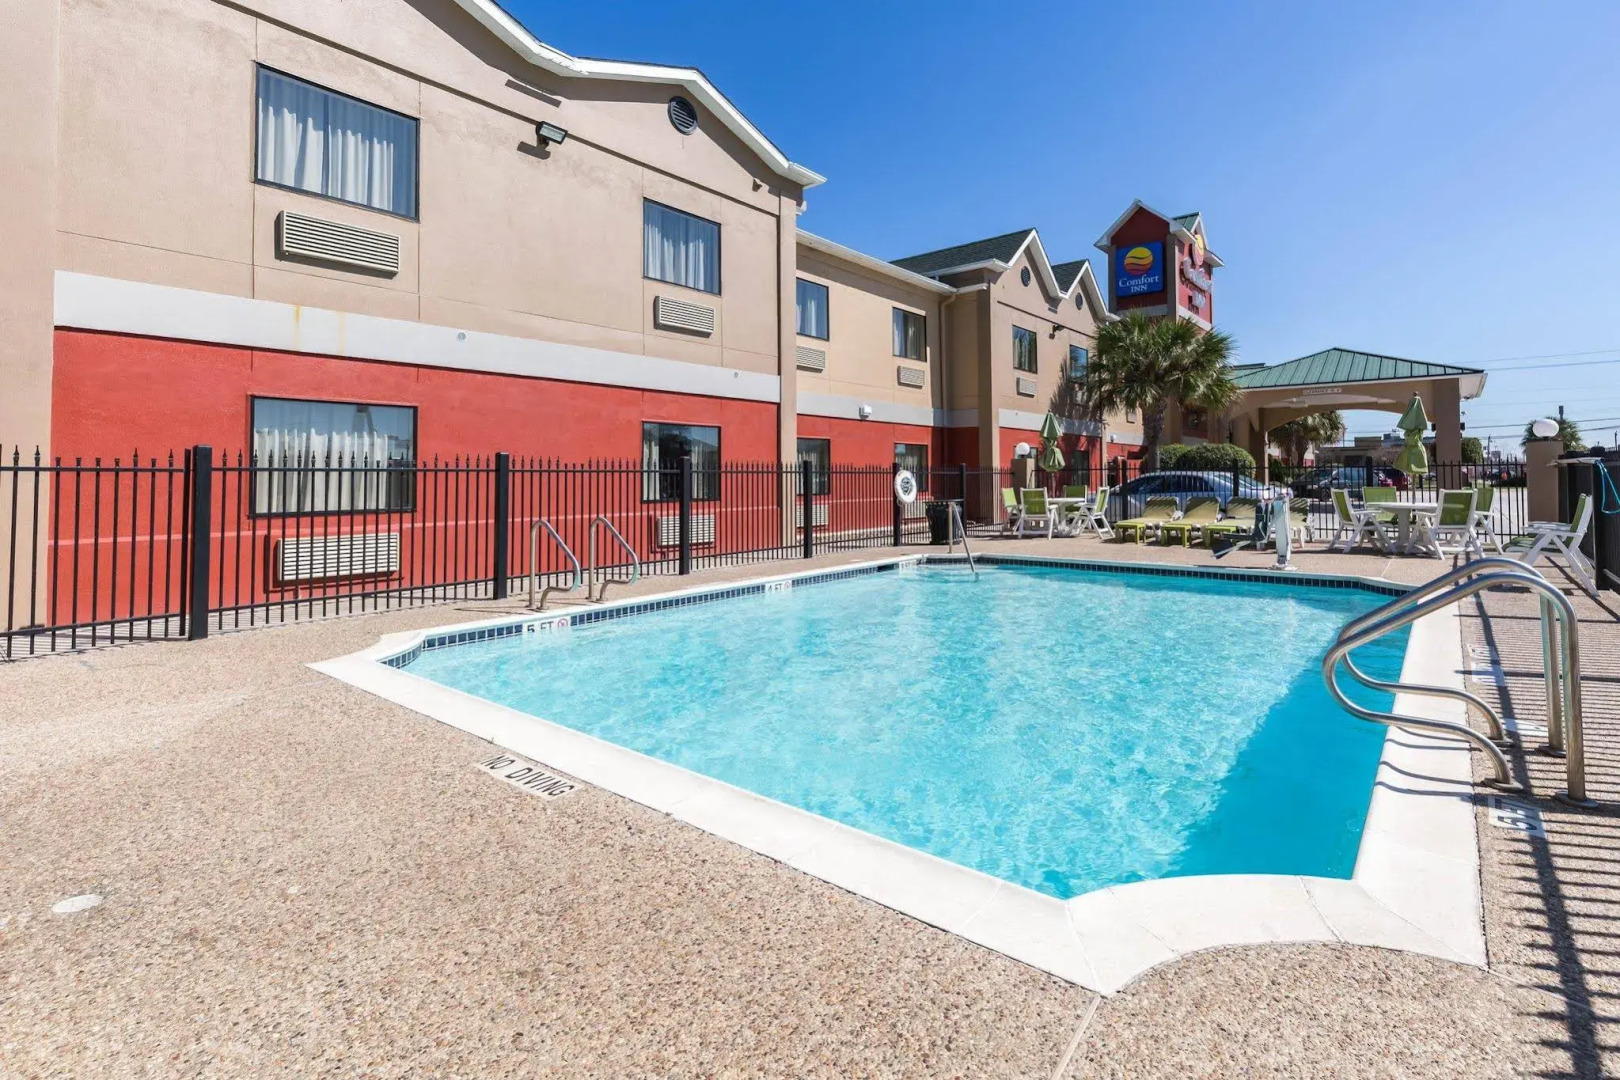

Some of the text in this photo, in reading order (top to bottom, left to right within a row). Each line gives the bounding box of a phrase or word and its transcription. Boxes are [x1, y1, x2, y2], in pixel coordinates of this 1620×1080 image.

[1118, 274, 1159, 288] Comfort
[1130, 284, 1147, 293] INN
[527, 621, 554, 633] 5 FT
[480, 755, 575, 797] NO DIVING
